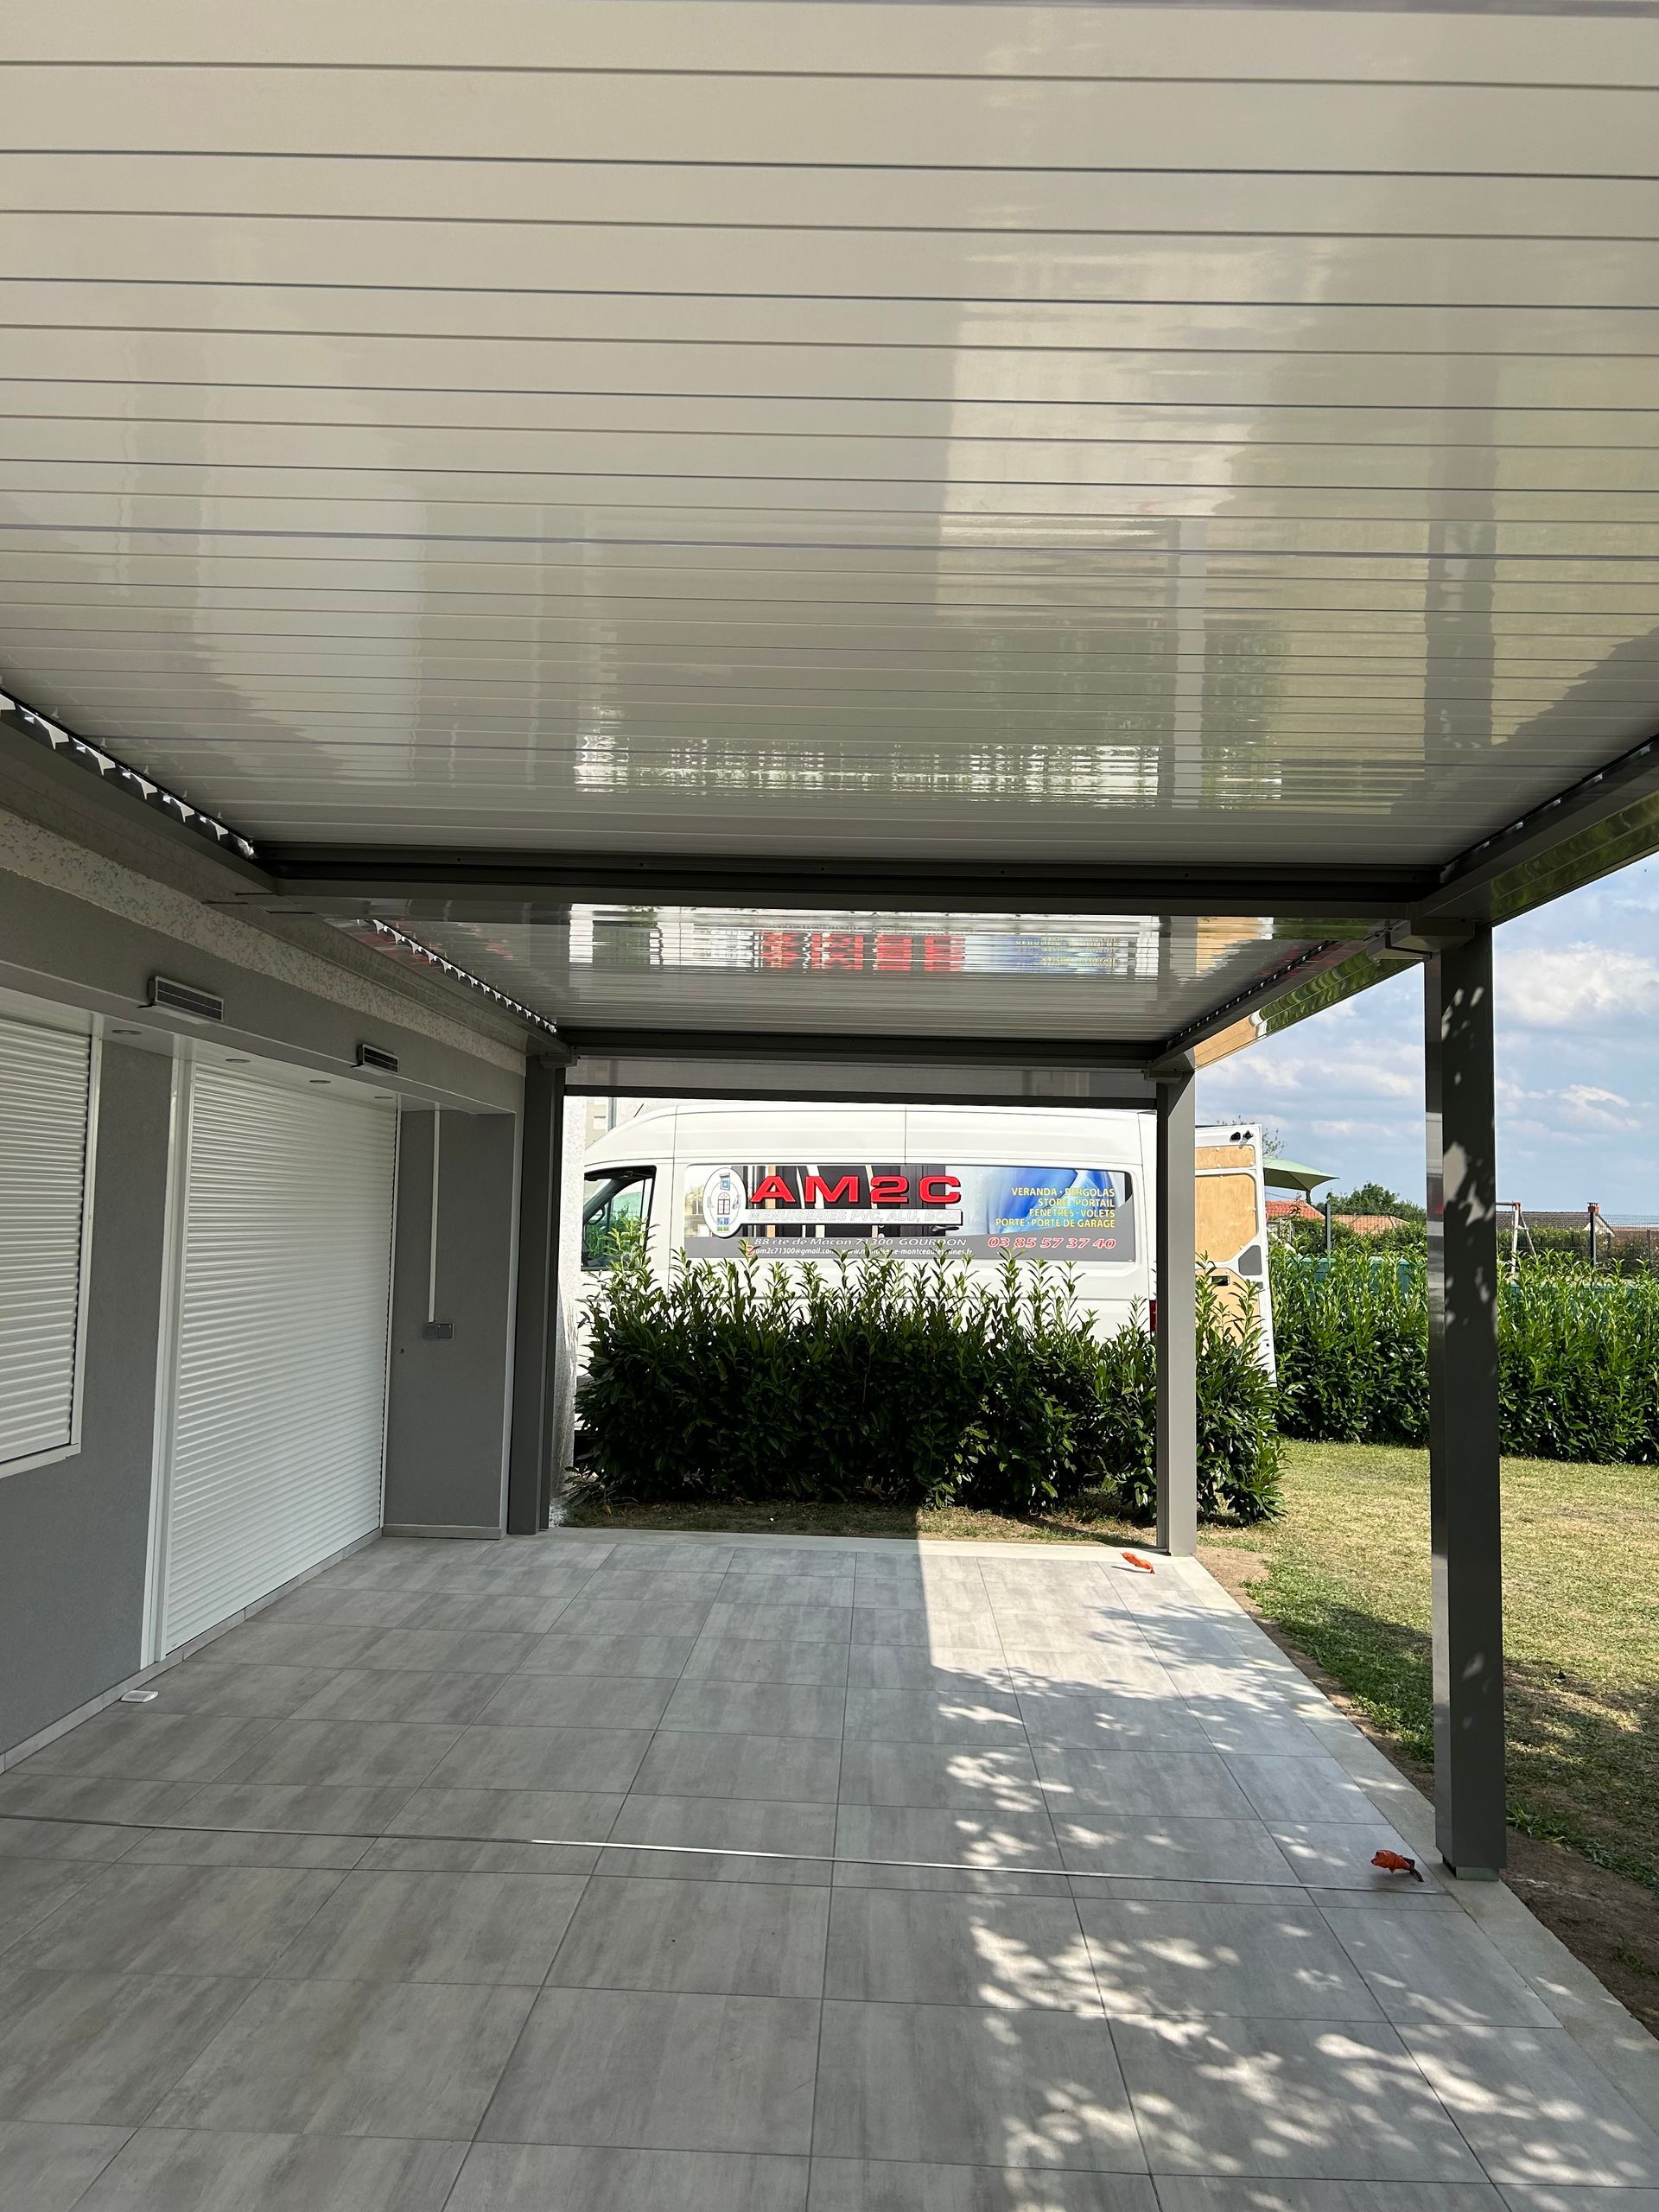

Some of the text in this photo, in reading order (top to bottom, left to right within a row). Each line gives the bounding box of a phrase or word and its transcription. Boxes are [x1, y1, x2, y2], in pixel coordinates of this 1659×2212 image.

[748, 1174, 961, 1205] AM2C
[1011, 1187, 1116, 1198] VERANDA PERGOLAS
[1038, 1198, 1116, 1208] STORE PORTAIL
[748, 1210, 960, 1223] MENUISERIES PVC, ALU, BOIS
[1080, 1209, 1116, 1218] VOLETS
[995, 1217, 1116, 1229] PORTE PORTE DE GARAGE
[987, 1236, 1116, 1249] 03 85 57 37 40
